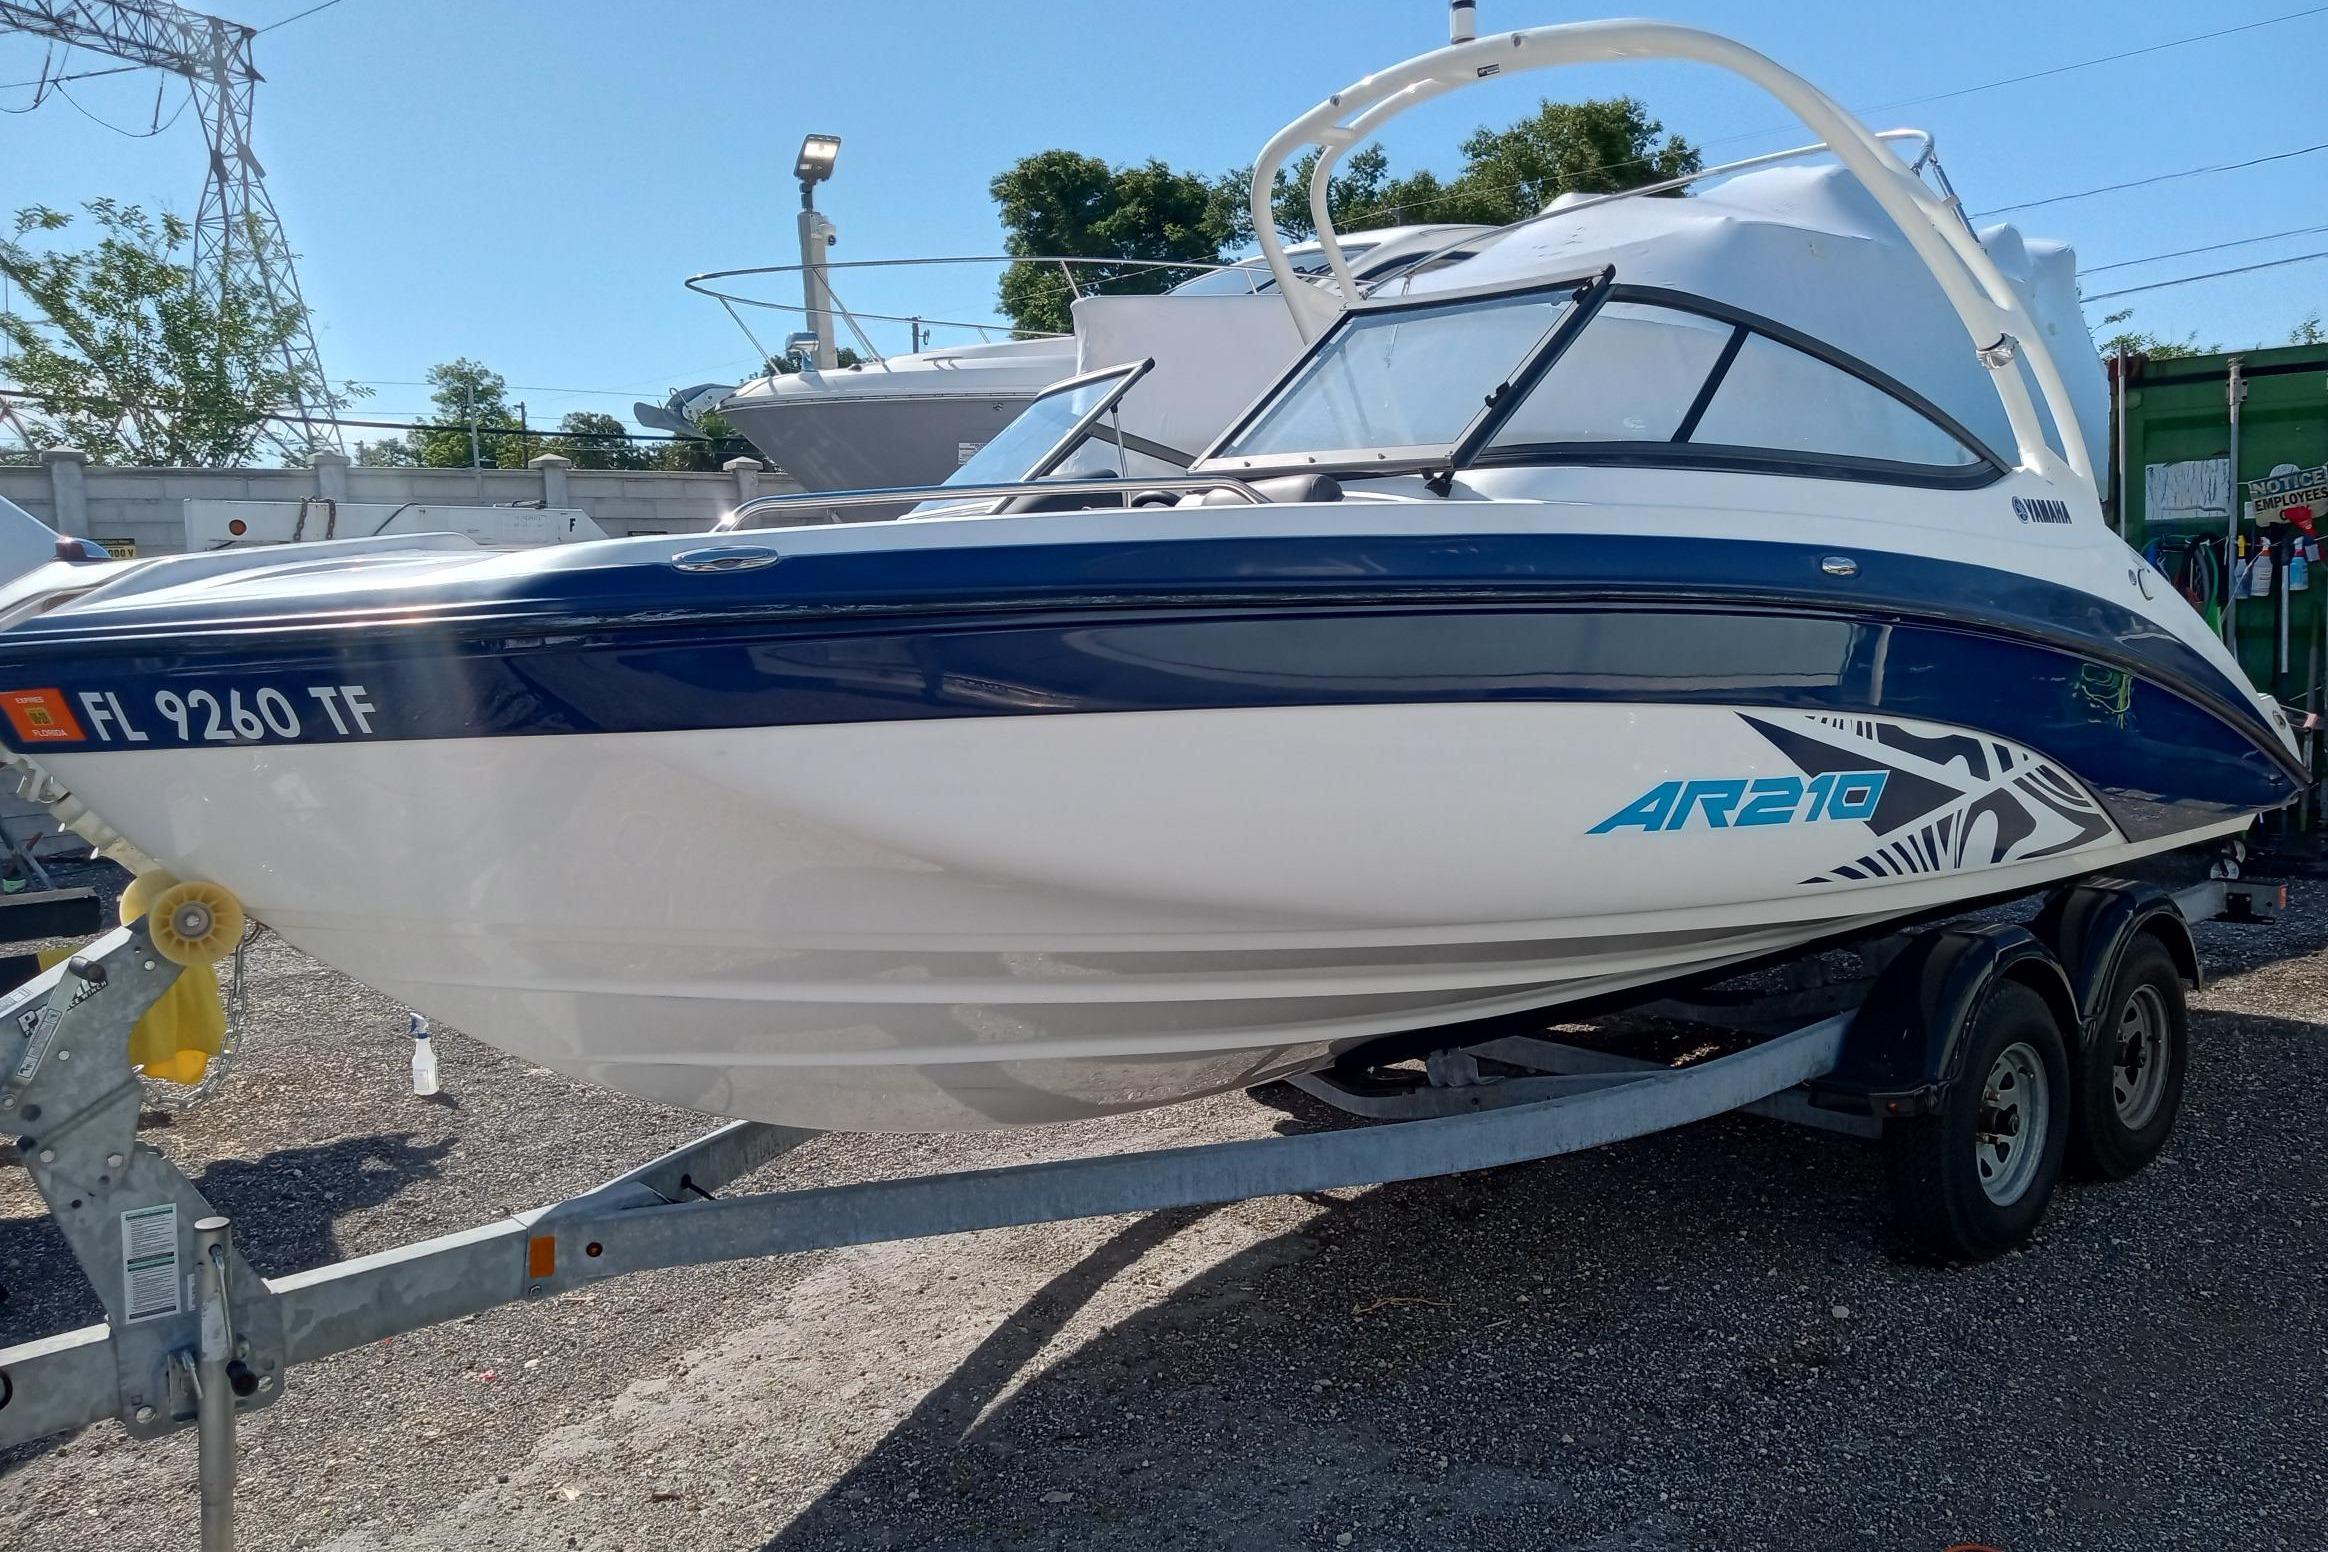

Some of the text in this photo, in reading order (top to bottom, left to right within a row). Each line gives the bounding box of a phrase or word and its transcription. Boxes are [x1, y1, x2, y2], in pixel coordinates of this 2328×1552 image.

[2249, 469, 2325, 495] NOTICE
[2023, 498, 2073, 524] YAMAHA
[2255, 487, 2328, 511] EMPLOYEES
[569, 518, 576, 532] F
[78, 686, 376, 741] FL 9260 TF
[32, 729, 68, 737] FLORIDA
[1584, 769, 1890, 835] AR210
